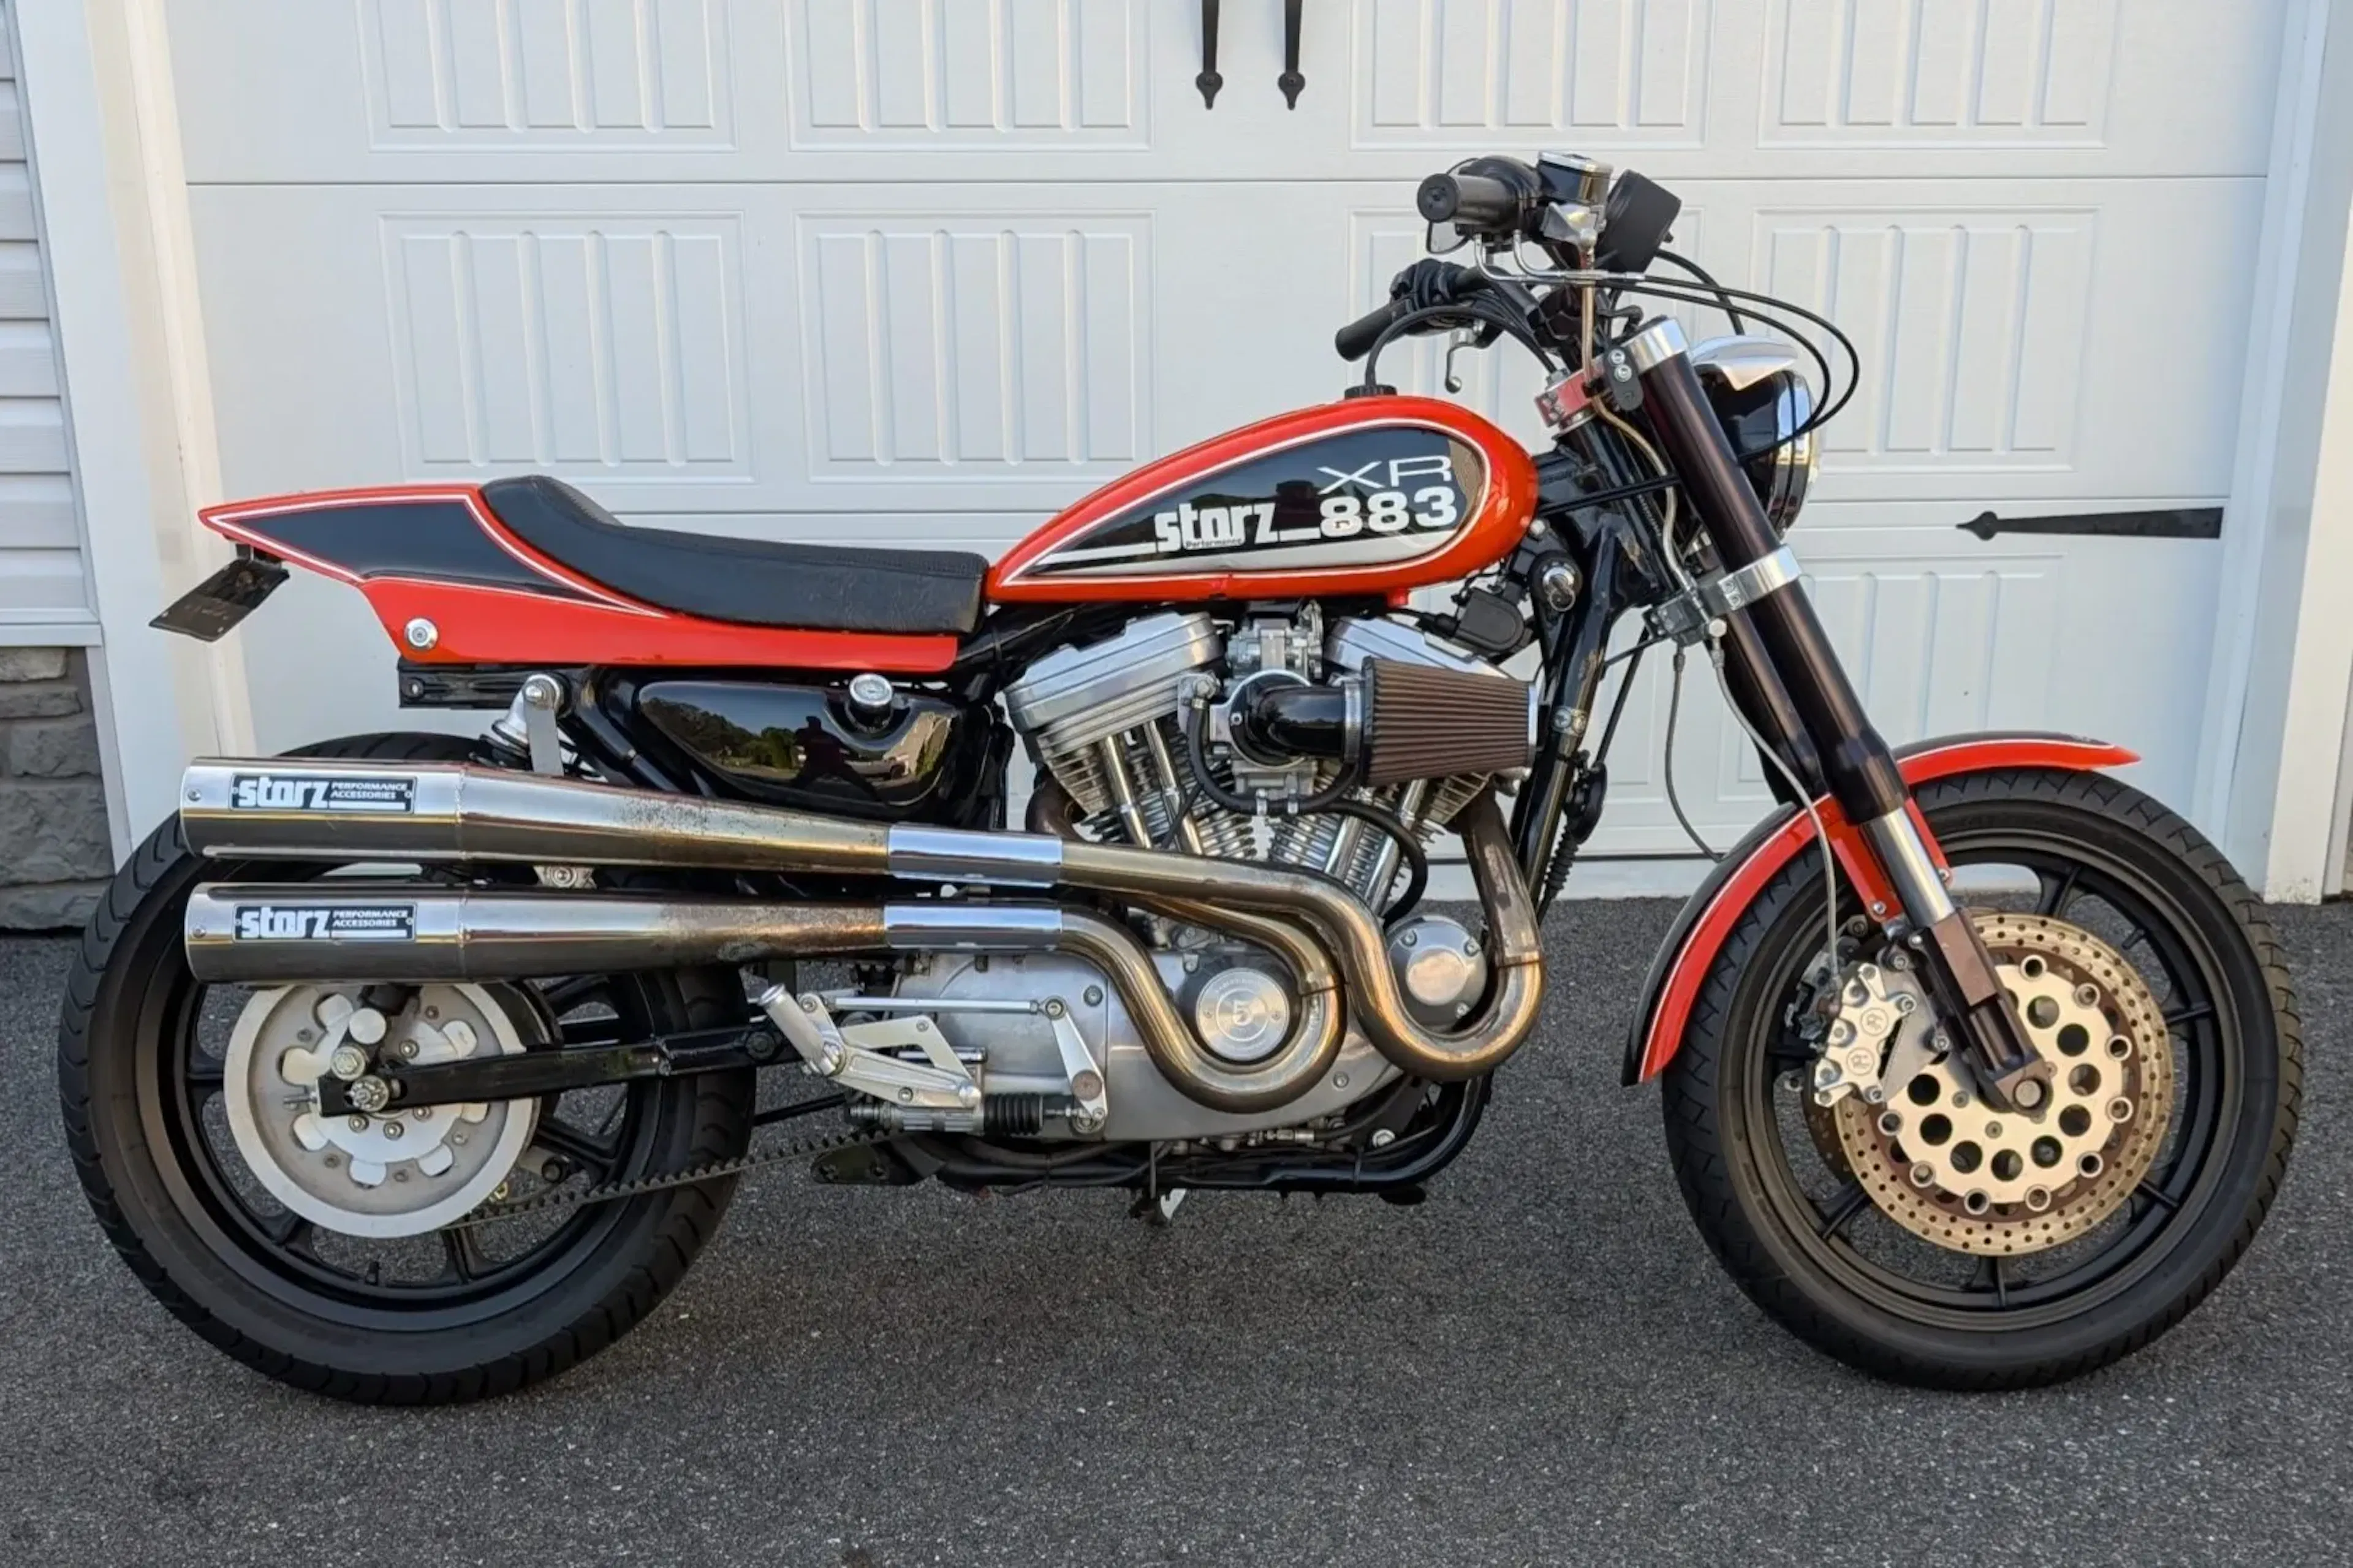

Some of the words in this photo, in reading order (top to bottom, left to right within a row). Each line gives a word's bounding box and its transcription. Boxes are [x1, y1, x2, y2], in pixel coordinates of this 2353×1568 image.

[1317, 455, 1452, 494] XR
[1154, 502, 1279, 552] storz
[1320, 486, 1457, 537] 883
[238, 776, 330, 808] storz
[330, 791, 397, 800] ACCESSORIES
[331, 782, 407, 791] PERFORMANCE
[241, 907, 330, 939] storz
[332, 910, 408, 919] PERFORMANCE
[332, 918, 398, 927] ACCESSORIES
